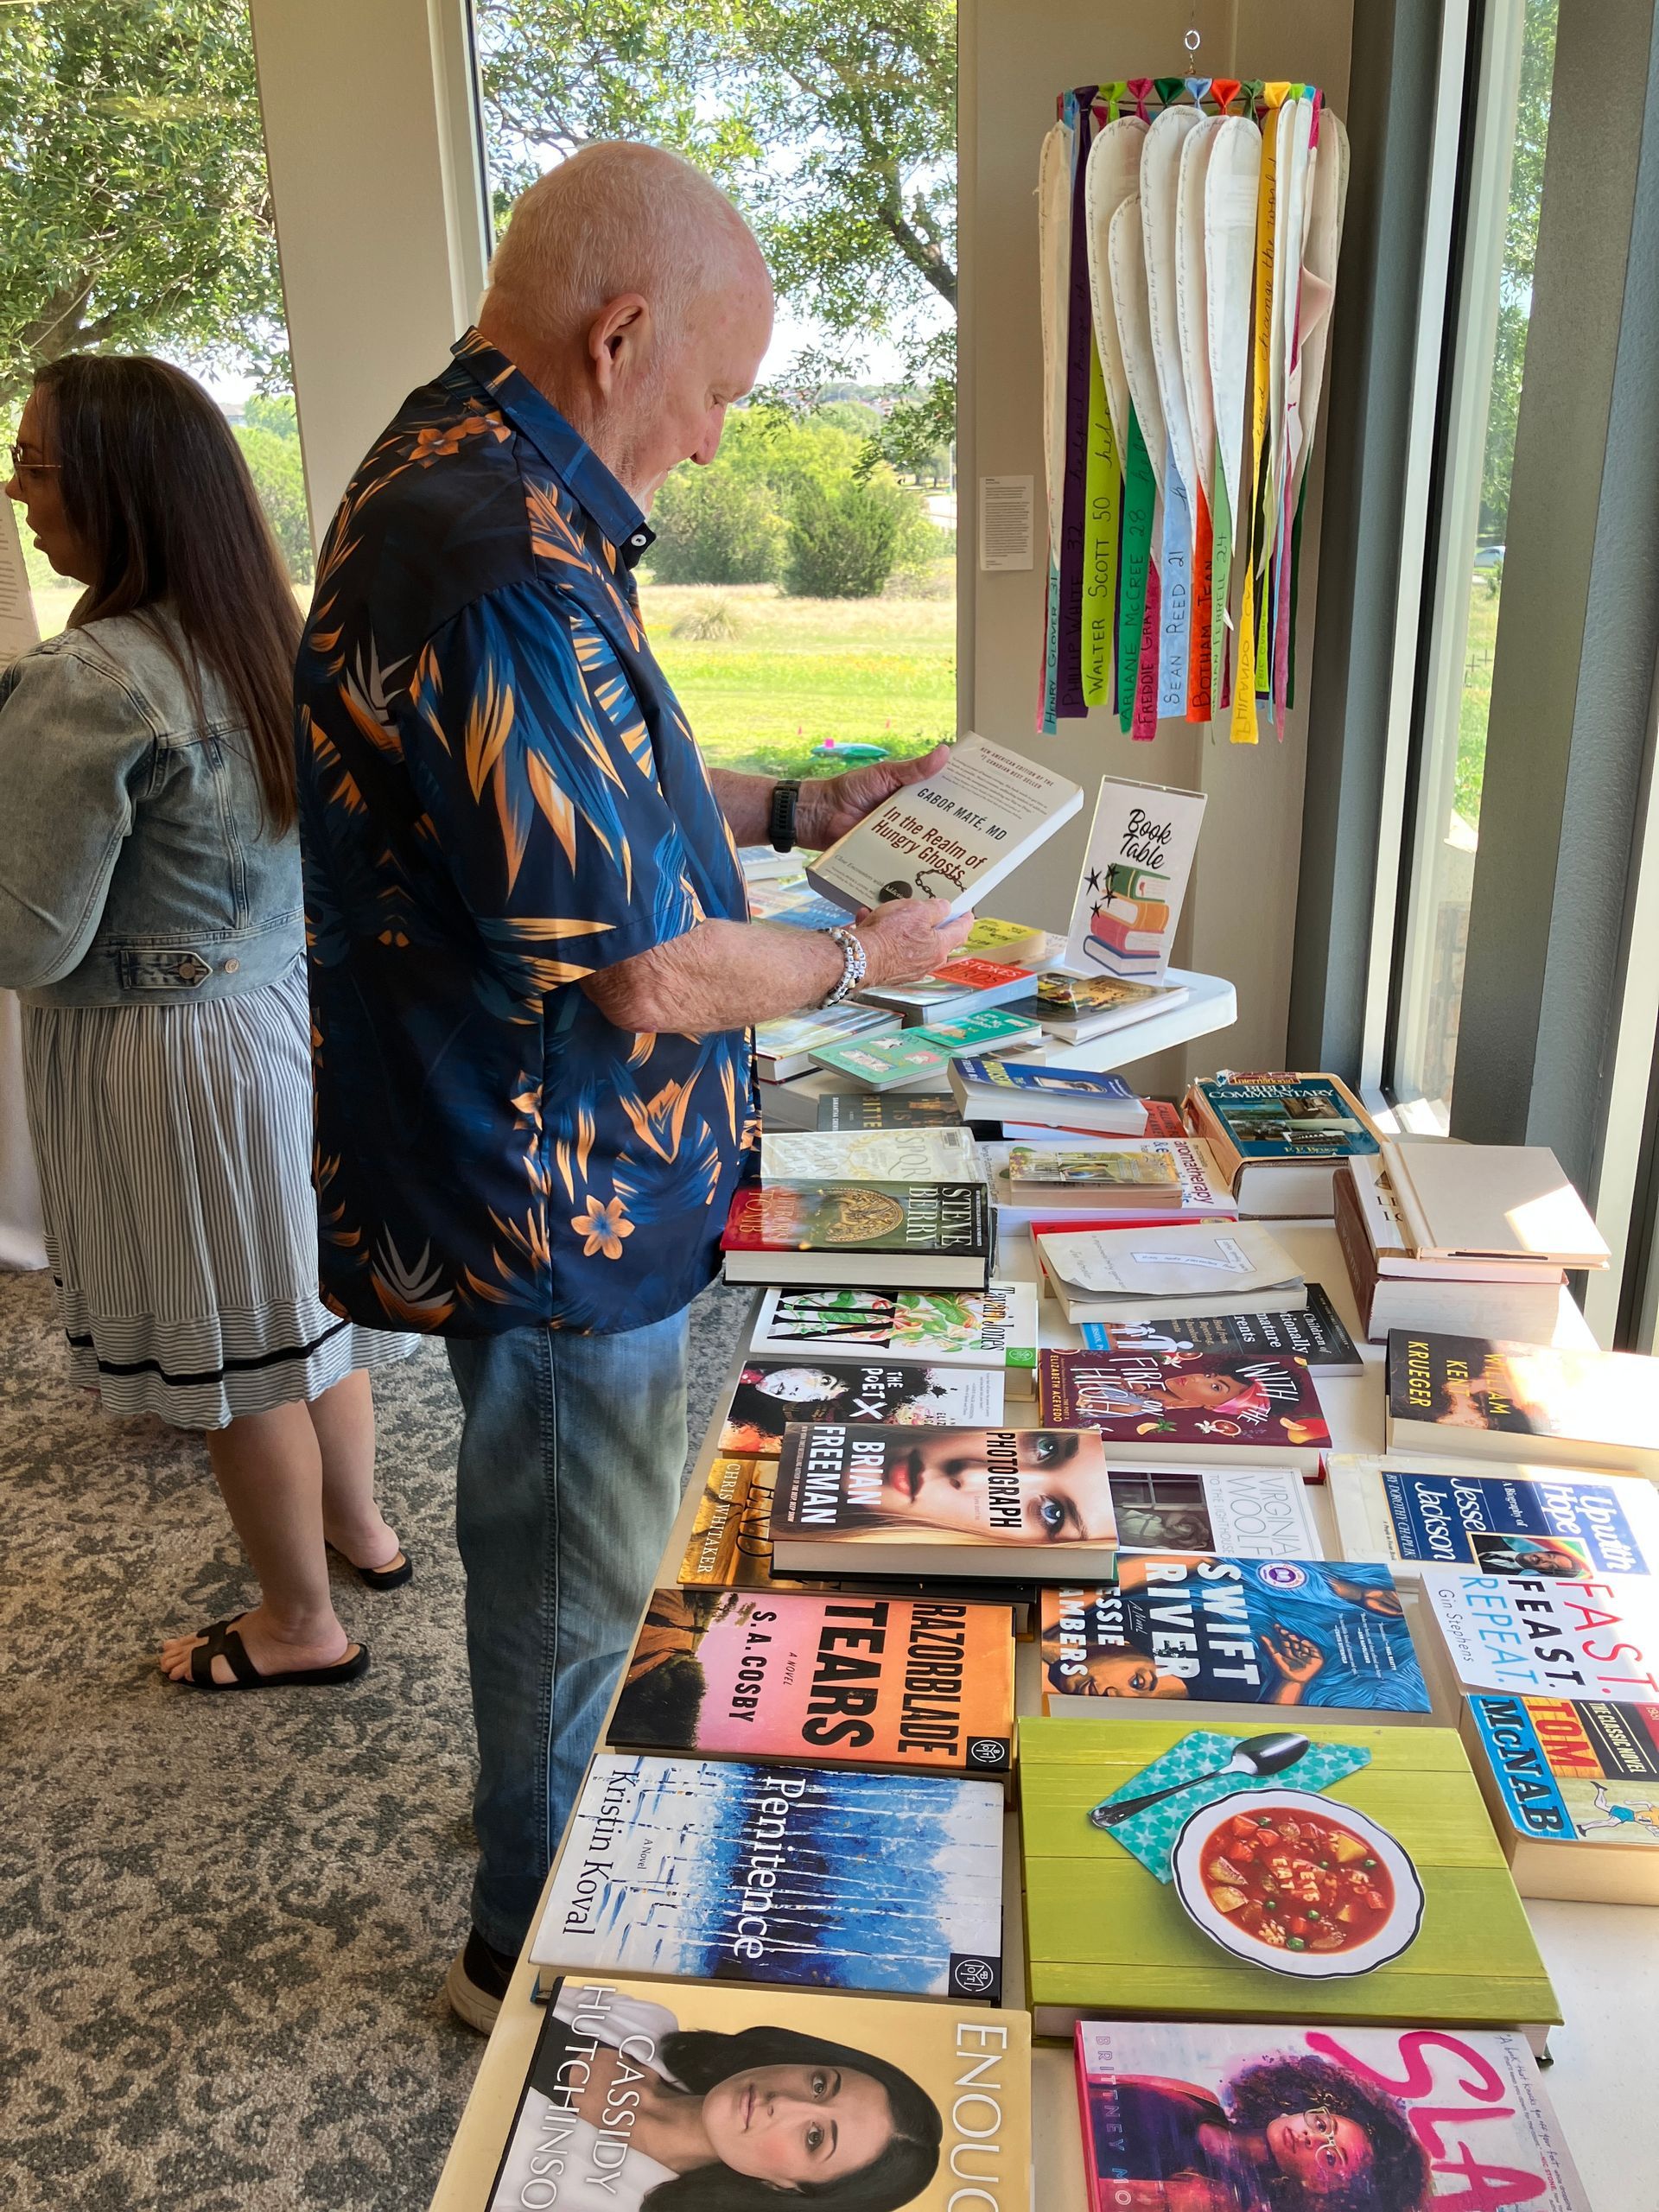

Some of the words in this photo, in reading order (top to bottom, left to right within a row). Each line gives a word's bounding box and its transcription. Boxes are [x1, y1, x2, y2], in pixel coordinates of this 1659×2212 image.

[1097, 497, 1111, 523] 50
[1087, 537, 1111, 599] SCOTT
[1168, 550, 1185, 568] 21
[1217, 532, 1229, 563] 24
[1049, 575, 1059, 594] 31
[1166, 583, 1187, 634] REED
[1047, 605, 1058, 668] GLOVER
[1122, 644, 1138, 721] ARIANE
[1130, 508, 1146, 536] 28
[1087, 617, 1105, 696] WALTER
[1164, 655, 1183, 706] SEAN
[1192, 621, 1212, 708] BOTHAM
[1045, 677, 1058, 725] HENRY
[1137, 664, 1155, 725] FREDDIE
[986, 758, 1011, 773] CANADIAN
[991, 753, 1016, 767] AMERICAN
[883, 805, 897, 819] In
[899, 812, 925, 836] the
[921, 826, 969, 861] Realm
[966, 855, 988, 870] of
[917, 788, 956, 812] GABOR
[953, 807, 988, 831] MATÉ,
[985, 824, 1008, 842] MD
[1128, 809, 1173, 844] Book
[871, 819, 921, 855] Hungry
[918, 847, 965, 880] Ghosts
[1118, 833, 1166, 870] Table
[958, 959, 1022, 978] STOKES
[862, 1095, 883, 1128] BITTE
[1208, 1089, 1335, 1099] COMMENTARY
[887, 1135, 932, 1179] SPQR
[1174, 1141, 1215, 1205] aromatherapy
[906, 1186, 939, 1243] BERRY
[941, 1186, 973, 1247] STEVE
[982, 1286, 1017, 1325] Tayari
[1234, 1314, 1256, 1344] rents
[980, 1323, 1016, 1351] Jones
[1302, 1312, 1326, 1346] Children
[1319, 1344, 1332, 1355] of
[860, 1368, 887, 1400] POET
[885, 1370, 904, 1389] THE
[1050, 1355, 1061, 1391] ELIZABETH
[1070, 1367, 1135, 1418] HIGH
[1108, 1356, 1167, 1392] FIRE
[1140, 1399, 1165, 1418] ON
[1235, 1361, 1300, 1402] WITH
[1408, 1341, 1432, 1408] KRUEGER
[1446, 1359, 1471, 1398] KENT
[1484, 1352, 1511, 1415] WILLIAM
[849, 1398, 888, 1420] X
[1051, 1390, 1064, 1422] ACEVEDO
[1236, 1406, 1272, 1427] THE
[719, 1463, 742, 1503] CHRIS
[800, 1426, 847, 1524] FREEMAN
[846, 1440, 886, 1506] BRIAN
[986, 1432, 1022, 1529] PHOTOGRAPH
[1209, 1474, 1222, 1485] TO
[1212, 1487, 1225, 1503] THE
[1385, 1473, 1398, 1485] BY
[1224, 1474, 1265, 1557] WOOLF
[1258, 1475, 1302, 1558] VIRGINIA
[1389, 1484, 1409, 1523] DOROTHY
[1414, 1481, 1457, 1561] Jackson
[1450, 1477, 1487, 1532] Jesse
[1505, 1487, 1524, 1521] Biography
[1516, 1519, 1529, 1528] of
[1540, 1482, 1582, 1535] Hope
[696, 1502, 731, 1573] WHITAKER
[1214, 1504, 1236, 1555] LIGHTHOUSE
[1397, 1522, 1417, 1560] CHAPLIK
[1591, 1523, 1637, 1571] with
[749, 1609, 778, 1628] S.
[1058, 1587, 1089, 1676] AMBERS
[1128, 1600, 1142, 1612] A
[1132, 1611, 1148, 1635] Novel
[1143, 1560, 1203, 1681] RIVER
[1196, 1560, 1261, 1687] SWIFT
[1437, 1589, 1455, 1611] Gin
[1446, 1612, 1475, 1663] Stephens
[1459, 1575, 1539, 1686] REPEAT.
[745, 1630, 763, 1651] A.
[1507, 1579, 1586, 1689] FEAST.
[1555, 1581, 1659, 1695] FAST.
[728, 1654, 767, 1723] COSBY
[782, 1659, 797, 1687] NOVEL
[801, 1601, 889, 1749] TEARS
[896, 1603, 967, 1757] RAZORBLADE
[1588, 1702, 1612, 1715] THE
[1597, 1714, 1631, 1747] CLASSIC
[1527, 1702, 1599, 1768] TOM
[1616, 1746, 1648, 1773] NOVEL
[588, 1769, 640, 1853] Kristin
[637, 1845, 652, 1870] Novel
[643, 1837, 654, 1846] A
[732, 1774, 808, 1961] Penitence
[562, 1860, 614, 1936] Koval
[519, 1984, 617, 2212] HUTCHINSO
[584, 2033, 657, 2196] CASSIDY
[1095, 2034, 1127, 2154] BRITTNEY
[1306, 2031, 1548, 2212] SLA
